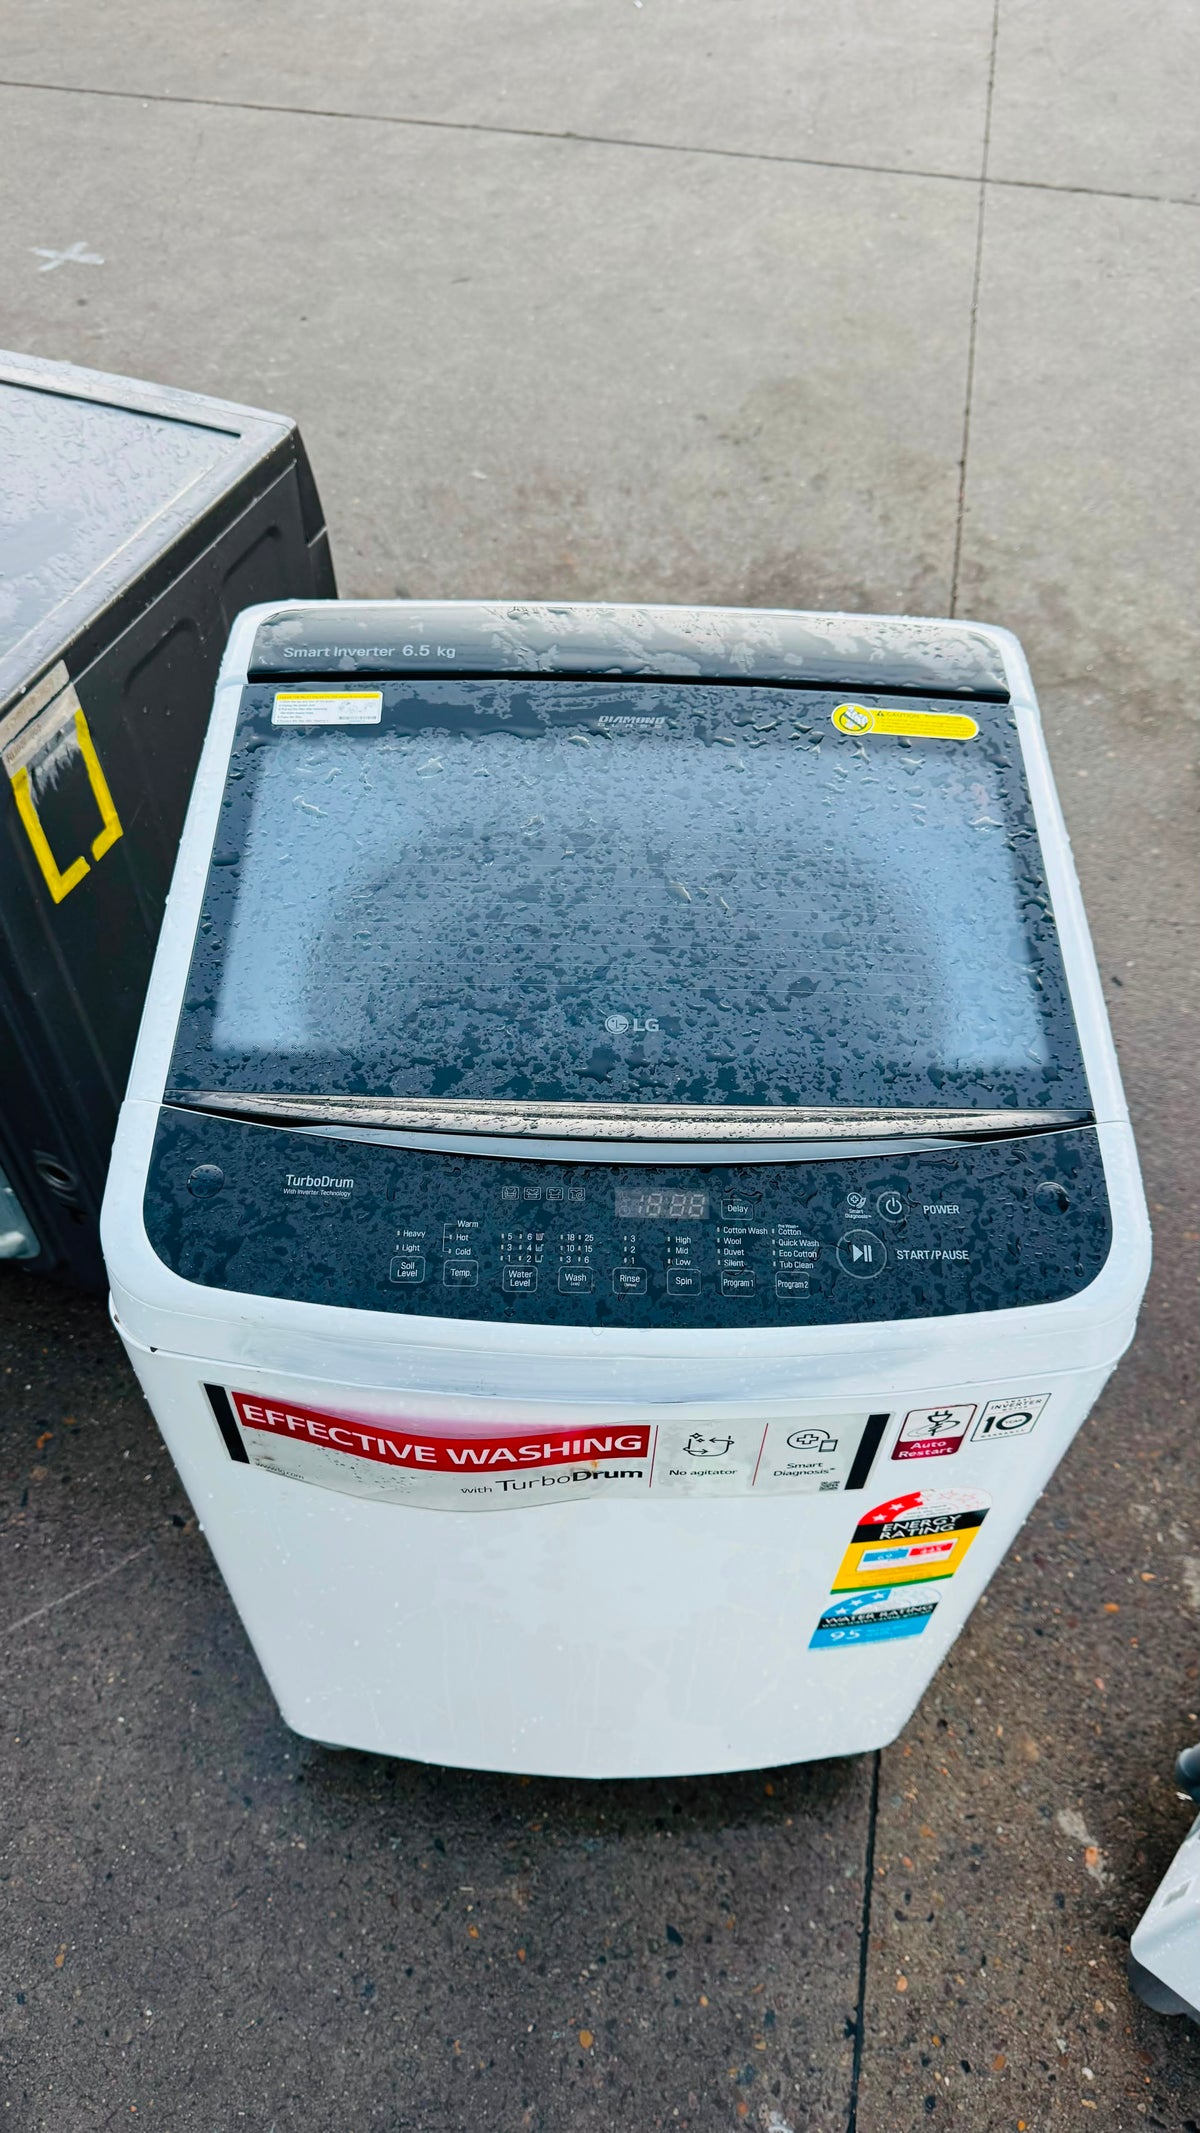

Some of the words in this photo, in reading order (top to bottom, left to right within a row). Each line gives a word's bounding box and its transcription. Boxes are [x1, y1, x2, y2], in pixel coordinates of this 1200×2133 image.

[284, 647, 330, 657] Smart
[334, 646, 395, 657] Inverter
[402, 644, 430, 657] 6.5
[437, 646, 456, 659] kg
[599, 715, 666, 724] DIAMOND
[633, 1018, 659, 1032] LG
[286, 1174, 354, 1188] TurboDrum
[727, 1204, 748, 1214] Delay
[923, 1205, 960, 1215] POWER
[457, 1220, 478, 1228] Warm
[403, 1230, 426, 1239] Heavy
[747, 1227, 768, 1235] Wash
[778, 1228, 802, 1236] Cotton
[584, 1234, 594, 1242] 25
[630, 1235, 636, 1243] 3
[675, 1236, 691, 1245] High
[799, 1239, 820, 1247] Wash
[402, 1244, 420, 1253] Light
[455, 1248, 471, 1256] Cold
[566, 1244, 575, 1252] 10
[630, 1246, 636, 1254] 2
[793, 1250, 817, 1258] Cotton
[896, 1250, 969, 1260] START/PAUSE
[526, 1255, 532, 1263] 2
[584, 1256, 590, 1264] 6
[675, 1258, 691, 1266] Low
[400, 1262, 415, 1270] Soil
[794, 1261, 814, 1269] Clean
[397, 1269, 418, 1277] Level
[450, 1268, 472, 1278] Temp.
[508, 1270, 533, 1278] Water
[564, 1273, 587, 1282] Wash
[510, 1279, 531, 1287] Level
[619, 1274, 641, 1283] Rinse
[675, 1277, 693, 1286] Spin
[723, 1279, 749, 1288] Program
[778, 1280, 804, 1289] Program
[991, 1399, 1042, 1410] INVERTER
[983, 1412, 1032, 1433] 10
[242, 1403, 437, 1463] EFFECTIVE
[446, 1435, 642, 1465] WASHING
[910, 1441, 947, 1449] Auto
[898, 1447, 953, 1458] Restart
[690, 1469, 738, 1477] agitator
[496, 1470, 643, 1492] TurboDrum
[882, 1515, 962, 1532] ENERGY
[879, 1523, 956, 1540] RATING
[825, 1613, 874, 1624] WATER
[879, 1605, 933, 1618] RATING
[830, 1630, 860, 1641] 95
